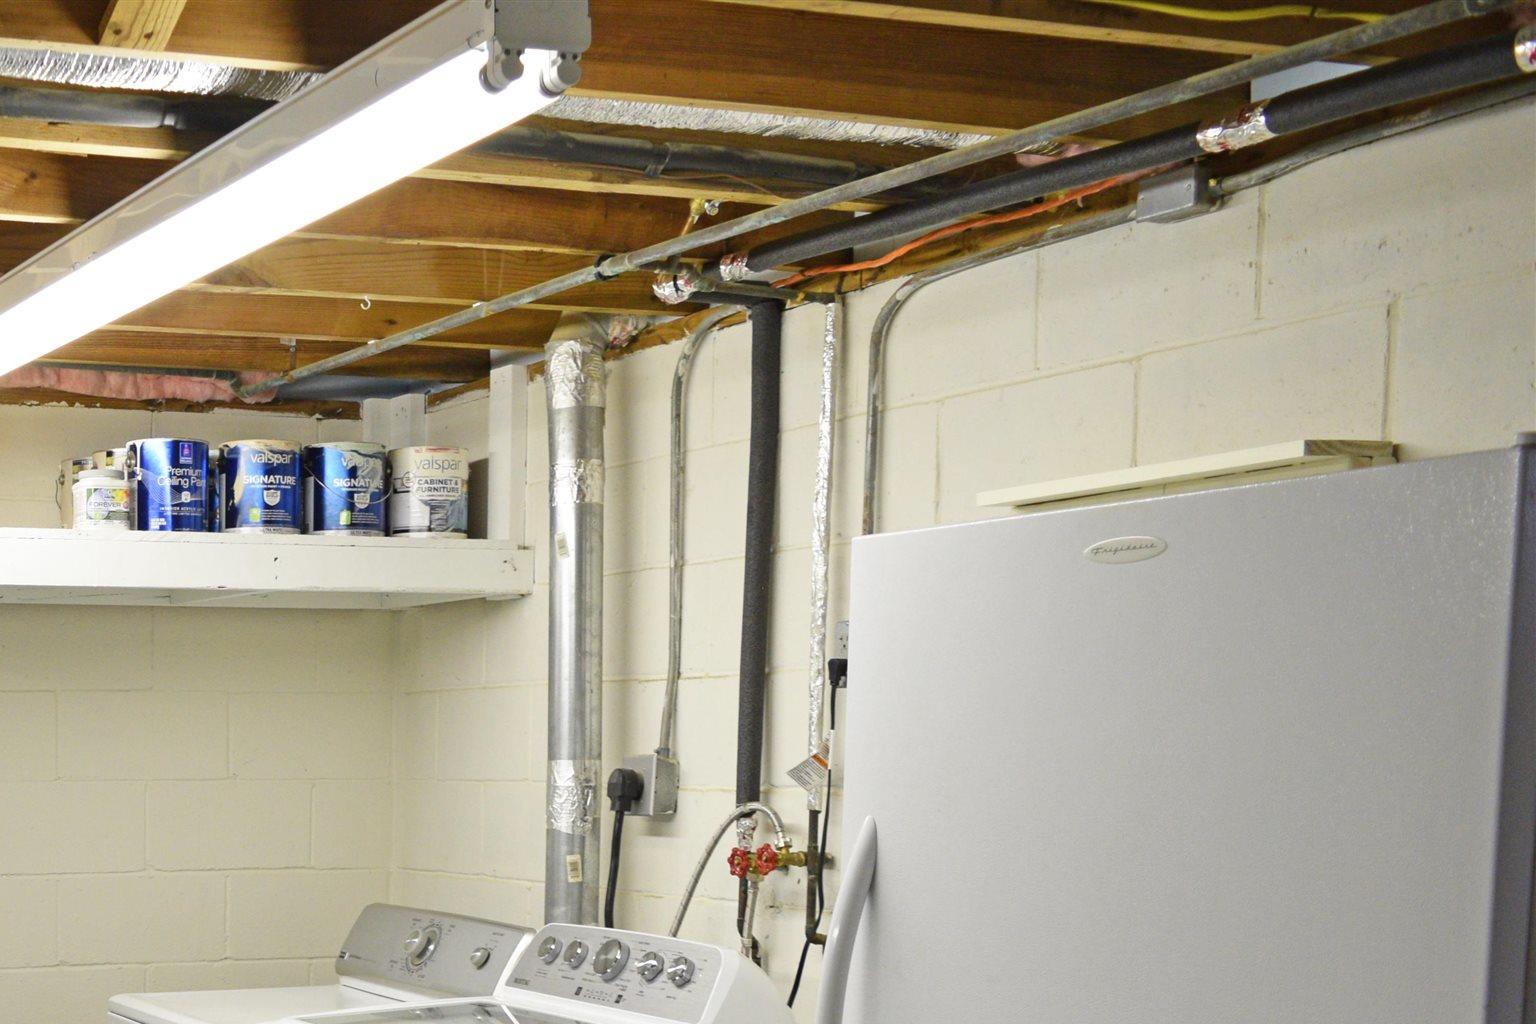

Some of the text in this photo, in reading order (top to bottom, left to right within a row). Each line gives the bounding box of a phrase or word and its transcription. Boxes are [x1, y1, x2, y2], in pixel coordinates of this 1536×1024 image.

[250, 451, 292, 466] valspar
[414, 456, 462, 472] valspar
[243, 474, 296, 485] SIGNATURE
[416, 486, 459, 494] FURNITURE
